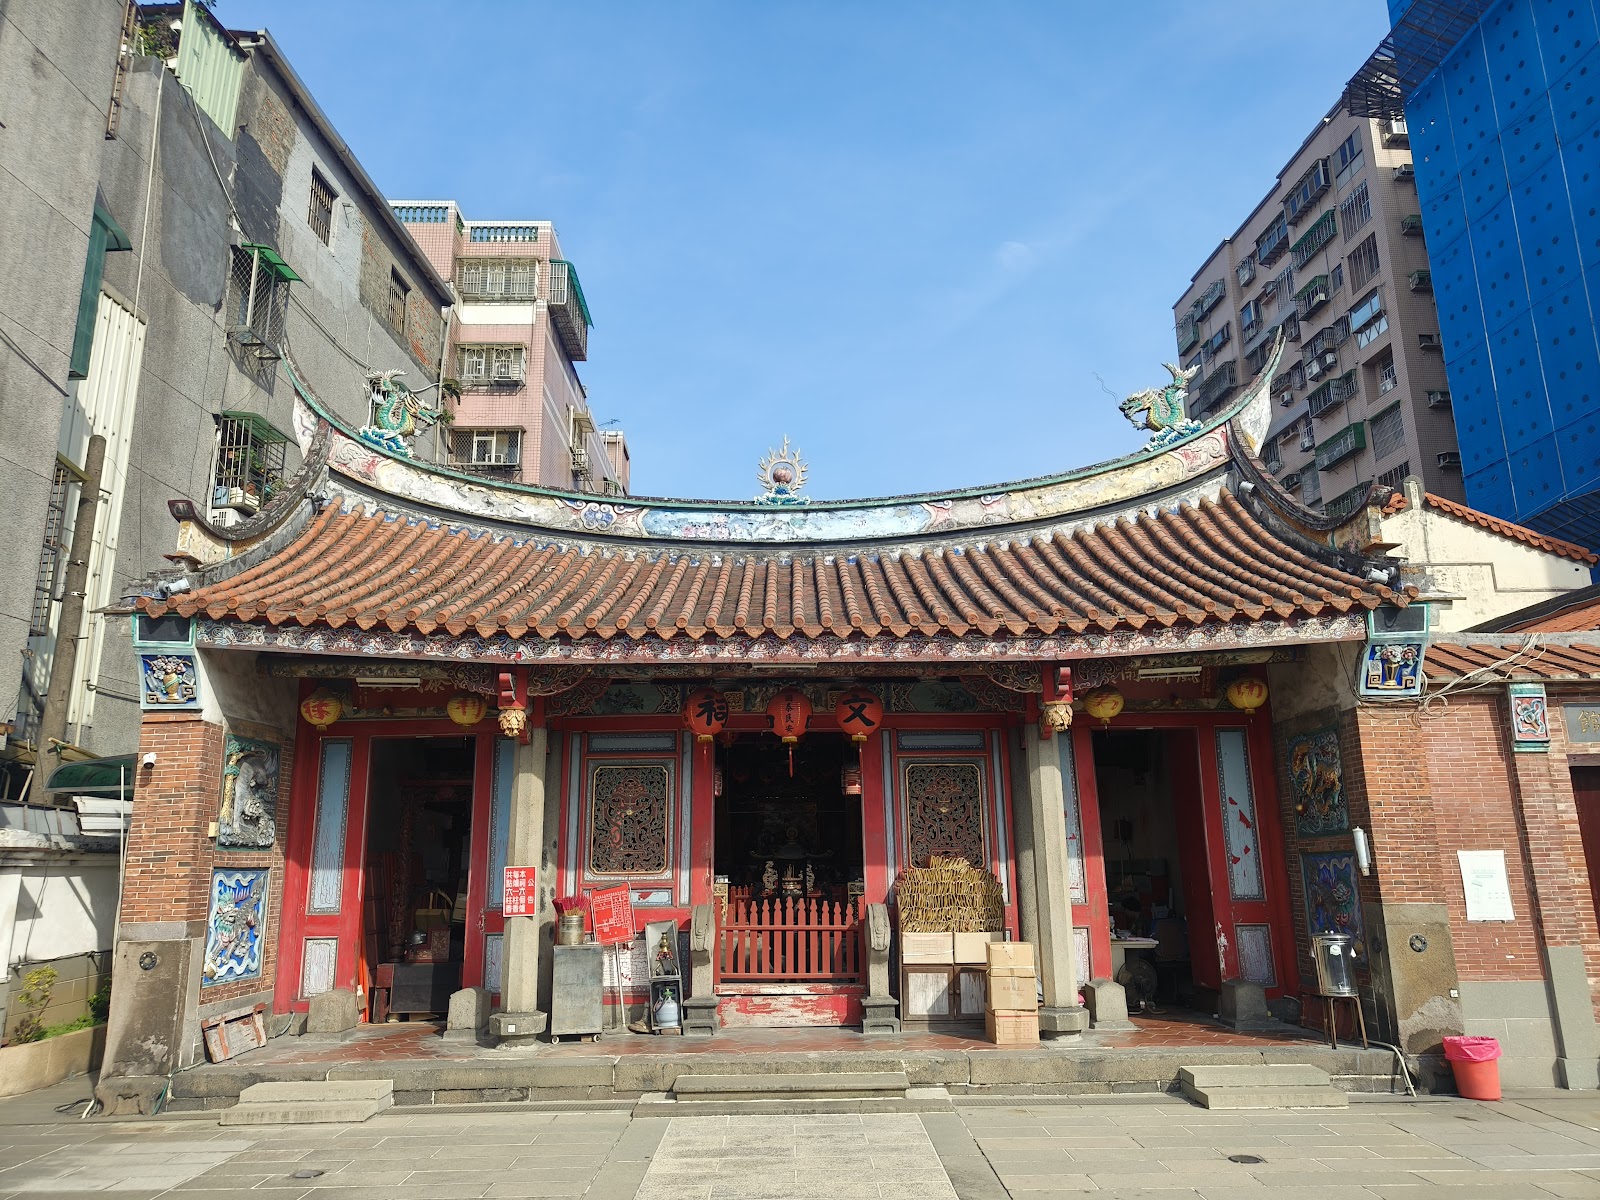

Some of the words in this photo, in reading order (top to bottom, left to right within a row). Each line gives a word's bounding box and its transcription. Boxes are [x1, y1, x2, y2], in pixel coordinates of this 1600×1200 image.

[695, 695, 729, 728] 祠
[784, 694, 794, 733] 國泰民安
[842, 694, 876, 727] 文
[519, 870, 527, 913] 本祠六個爐
[527, 878, 534, 904] 公告
